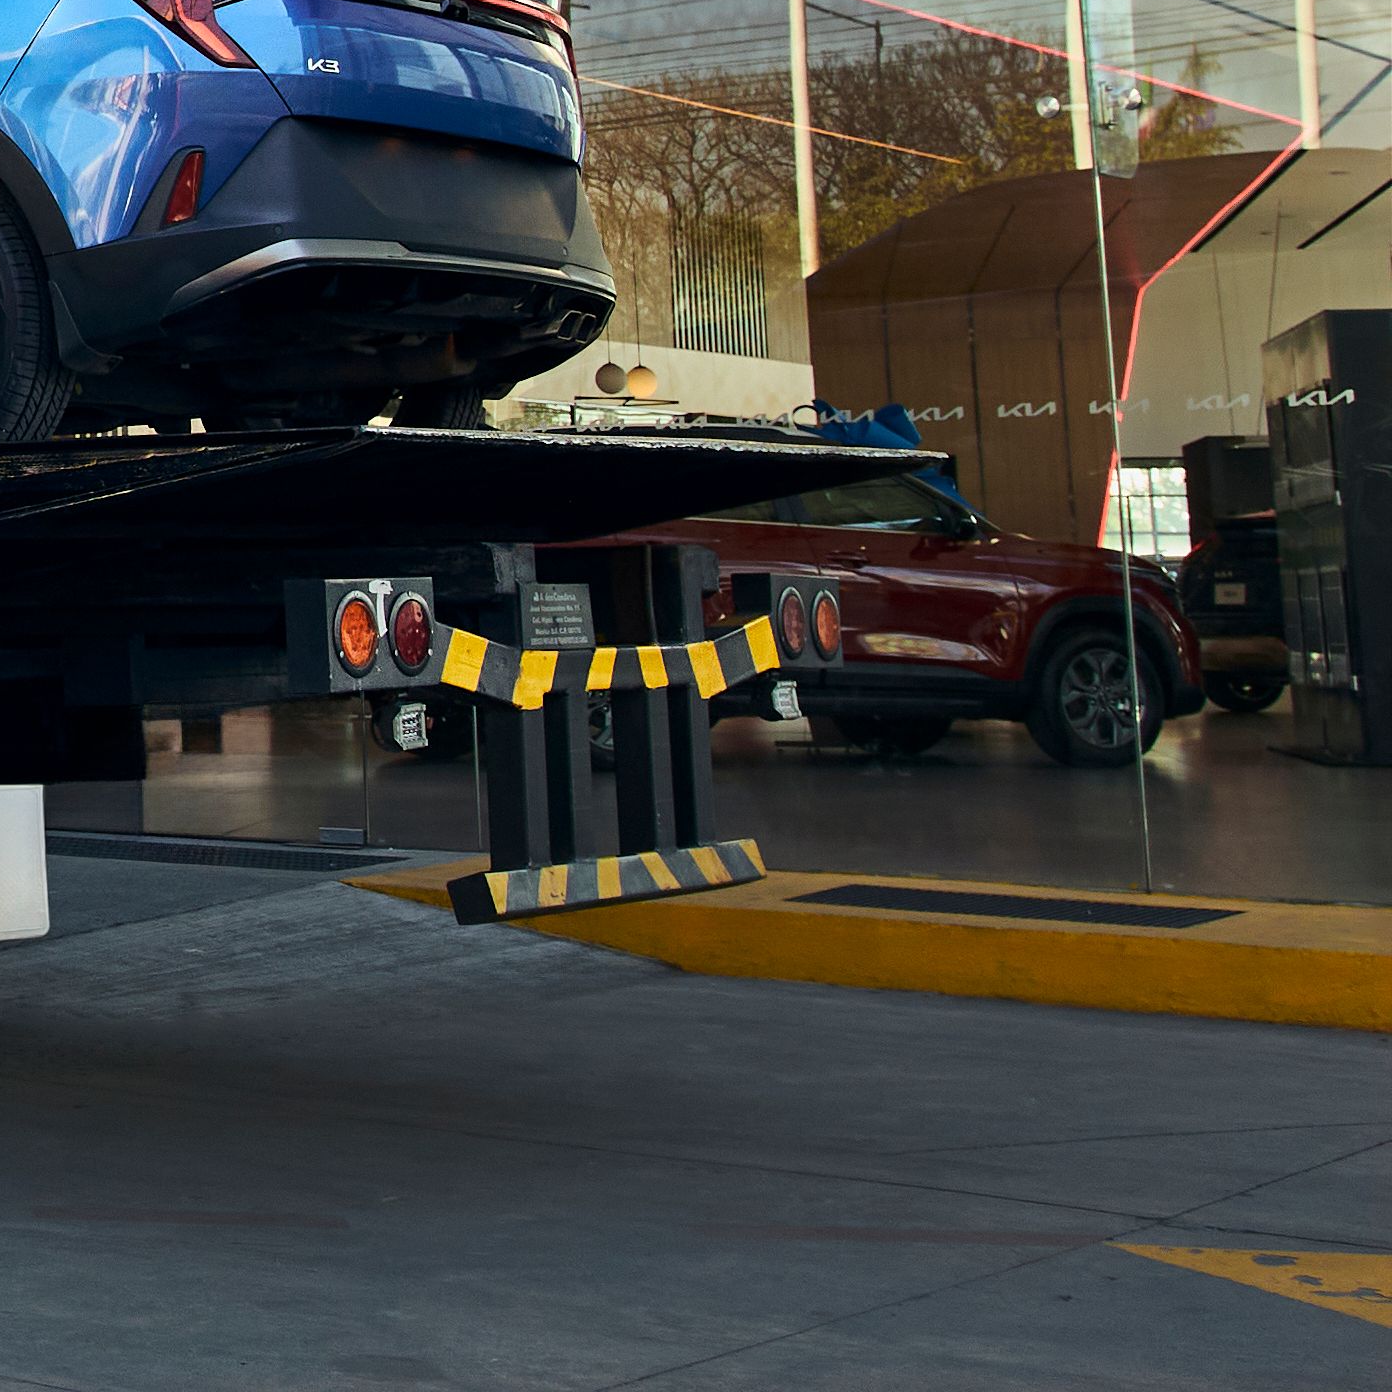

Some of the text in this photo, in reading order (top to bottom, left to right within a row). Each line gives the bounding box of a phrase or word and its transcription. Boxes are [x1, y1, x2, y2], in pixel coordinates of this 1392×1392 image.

[307, 58, 340, 74] K3
[997, 400, 1056, 418] KIA
[1287, 388, 1355, 408] KIA
